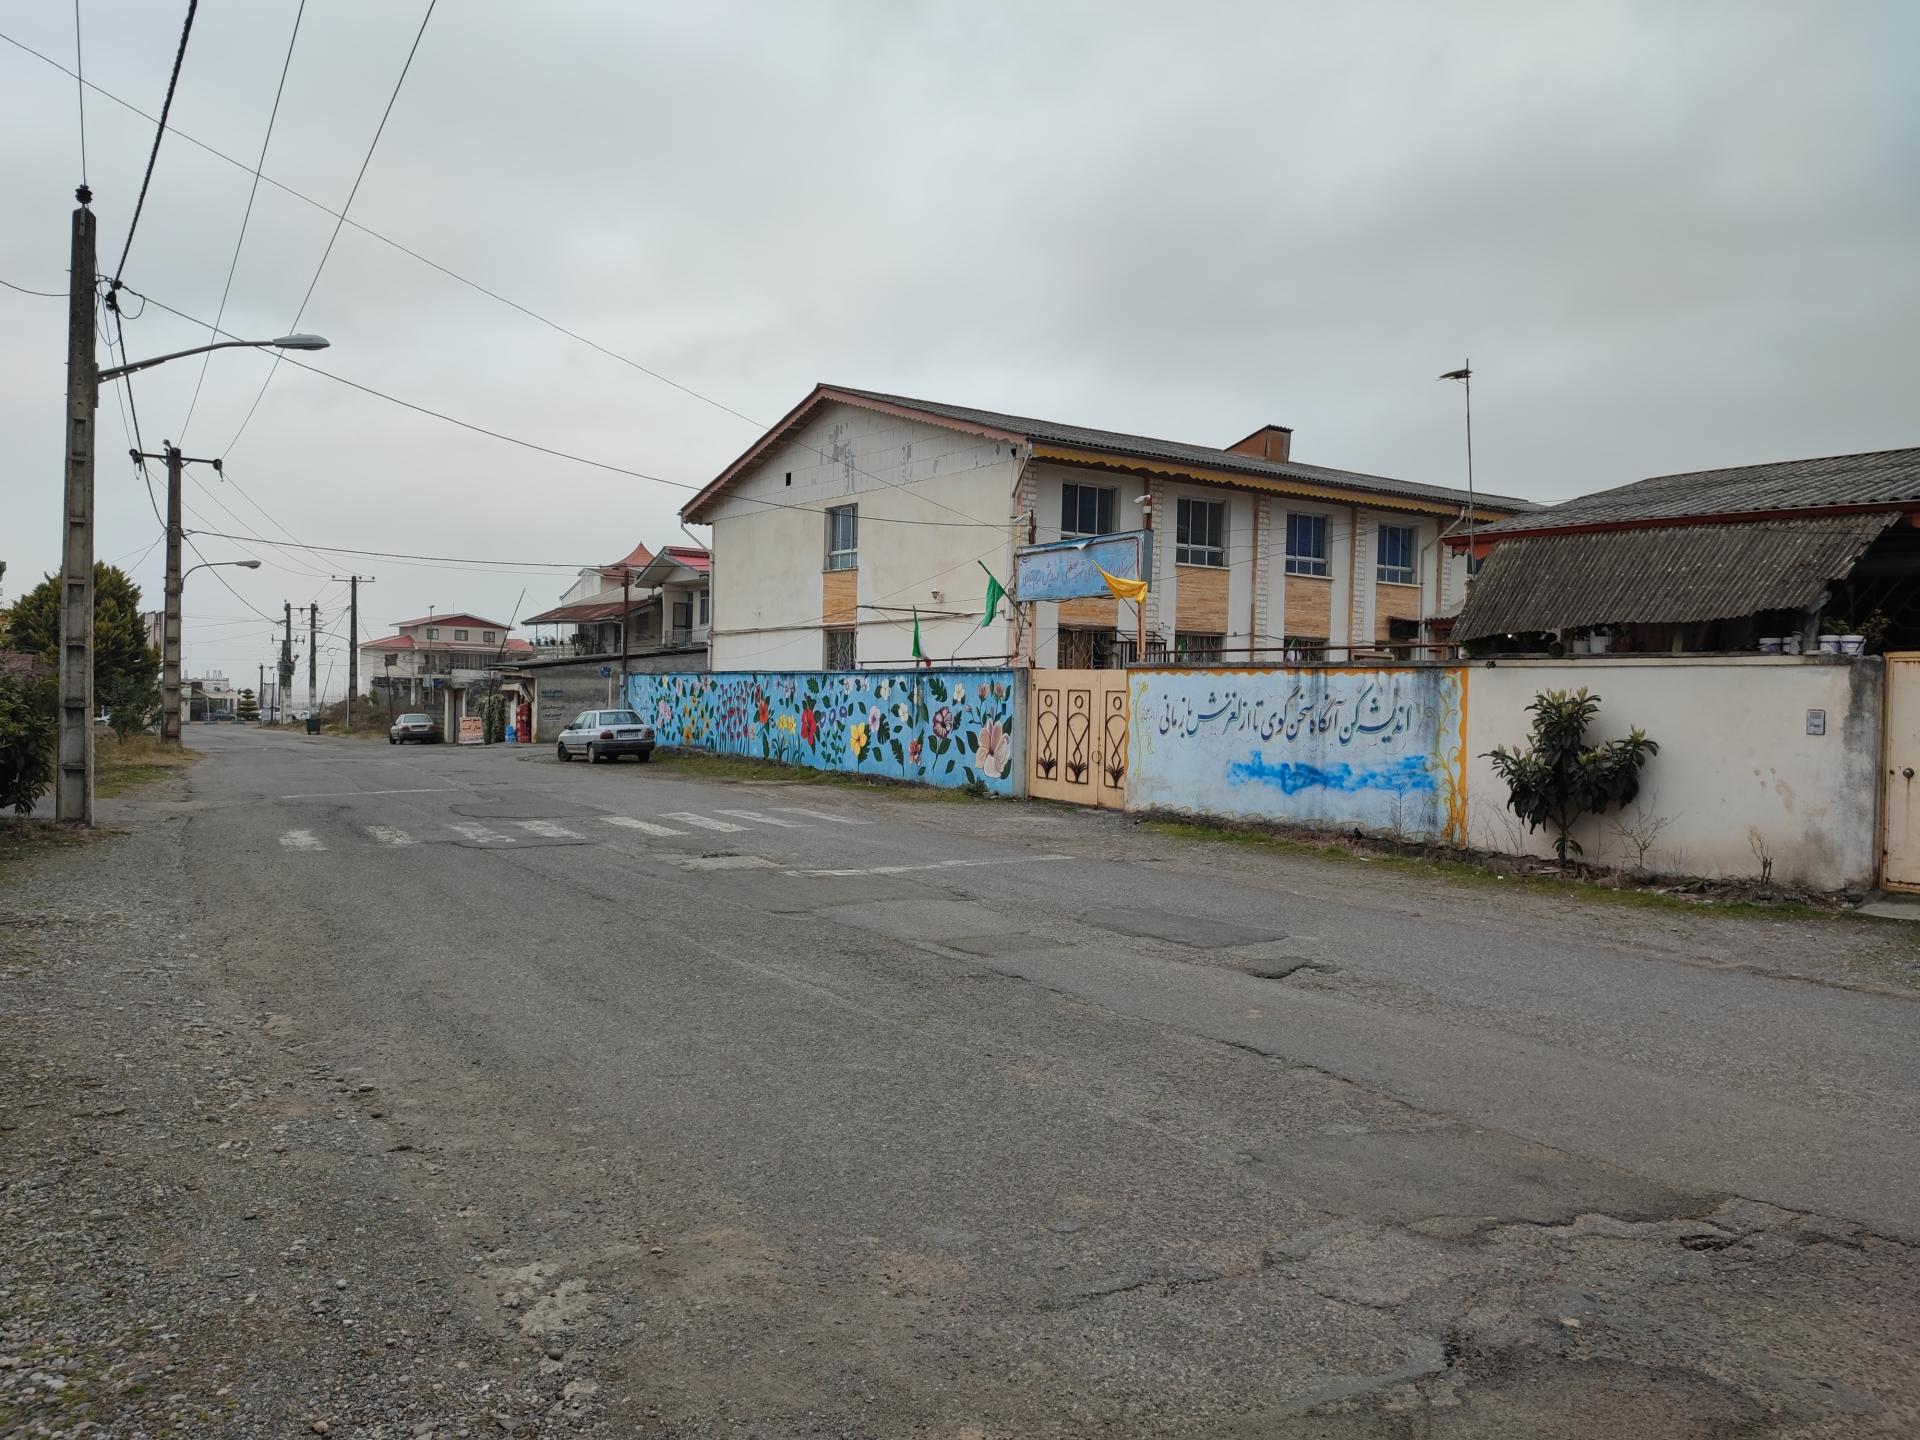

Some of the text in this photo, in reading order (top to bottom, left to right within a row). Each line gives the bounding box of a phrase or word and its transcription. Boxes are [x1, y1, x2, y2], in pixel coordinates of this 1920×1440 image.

[1186, 691, 1242, 737] لغزش
[1238, 701, 1252, 731] از
[1253, 699, 1265, 732] تا
[1261, 684, 1301, 741] گوی
[1286, 693, 1315, 741] سخن
[1339, 683, 1375, 746] کن
[1357, 696, 1412, 744] اندیشه
